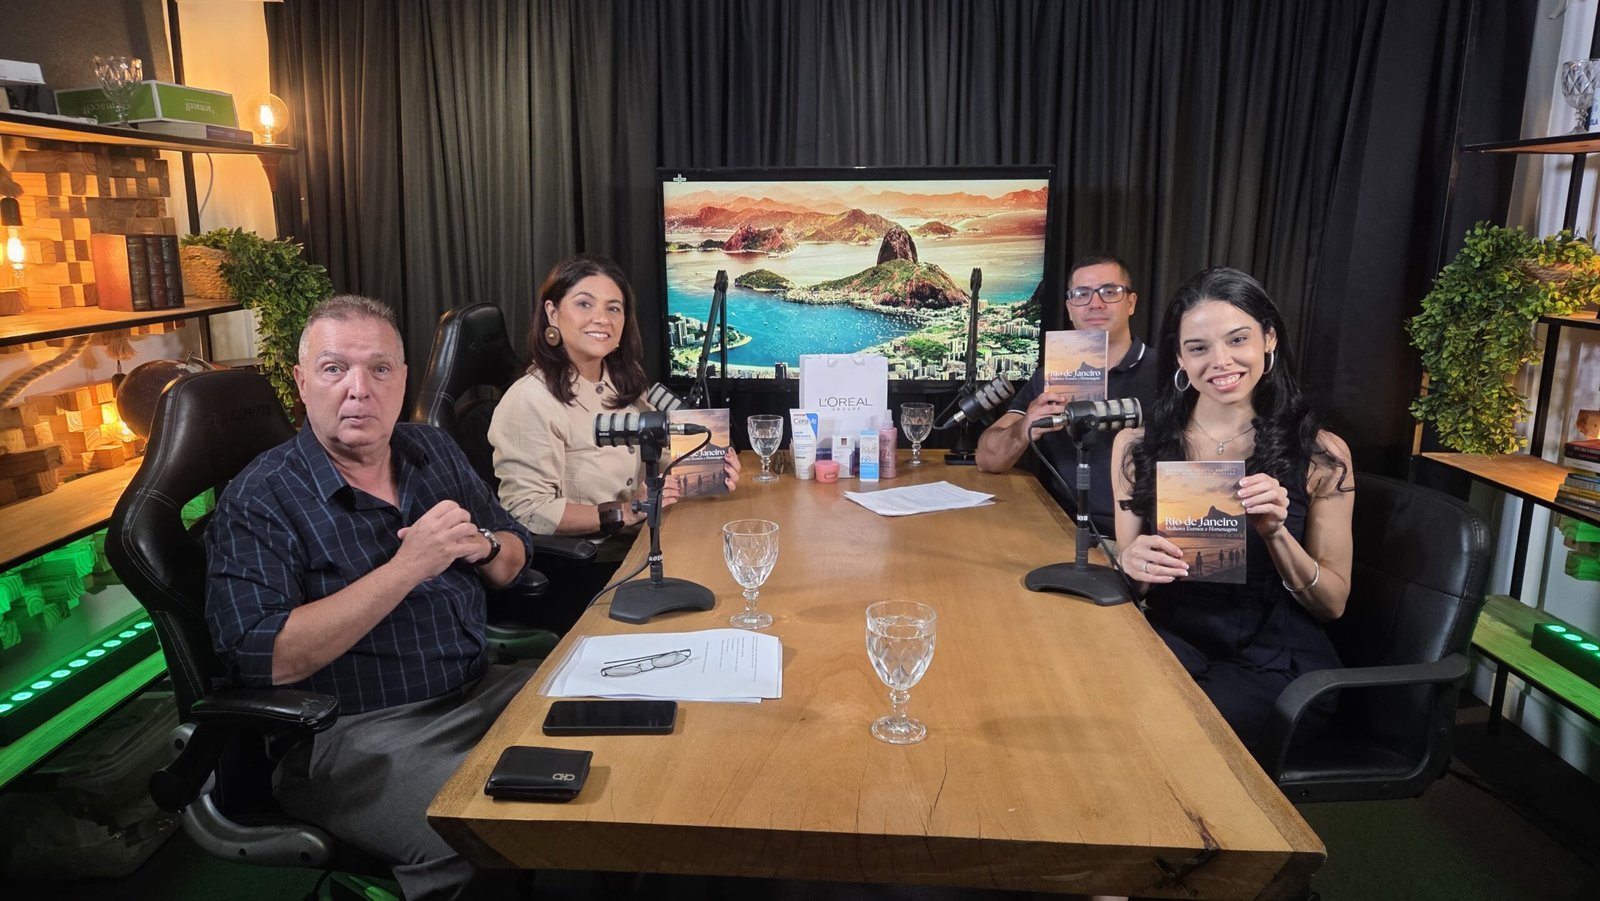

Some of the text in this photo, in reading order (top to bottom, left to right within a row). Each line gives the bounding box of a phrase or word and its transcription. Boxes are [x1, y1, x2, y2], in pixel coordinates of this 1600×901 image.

[1064, 369, 1072, 377] de
[793, 417, 817, 425] CeraVe
[698, 449, 725, 458] Janeiro
[1165, 516, 1238, 528] Rio de Janeiro
